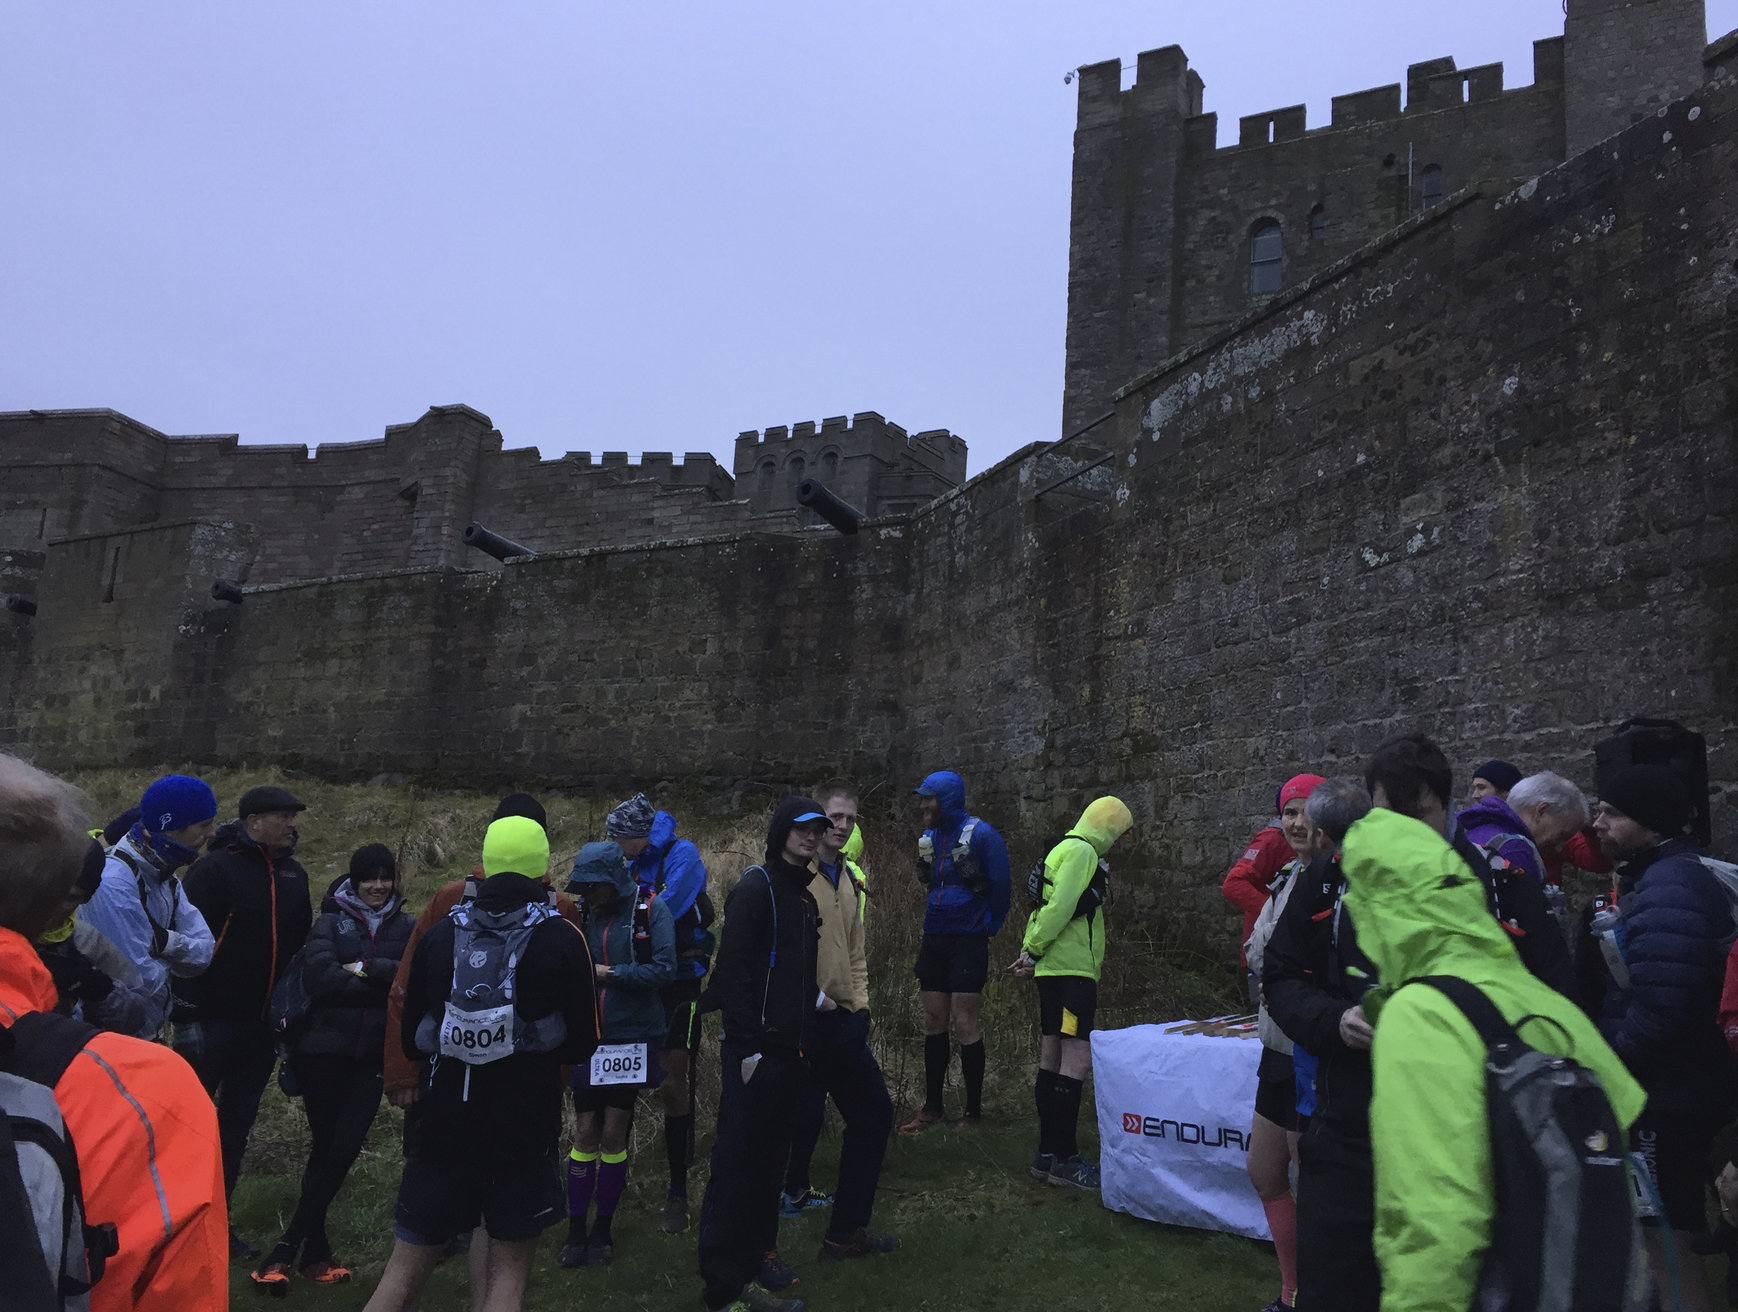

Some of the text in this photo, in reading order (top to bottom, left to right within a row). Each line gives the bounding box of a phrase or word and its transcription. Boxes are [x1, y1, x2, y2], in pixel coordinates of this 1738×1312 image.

[443, 1021, 452, 1046] ULTRA
[451, 1024, 506, 1049] 0804
[602, 1057, 642, 1073] 0805
[1143, 1116, 1250, 1151] ENDUR
